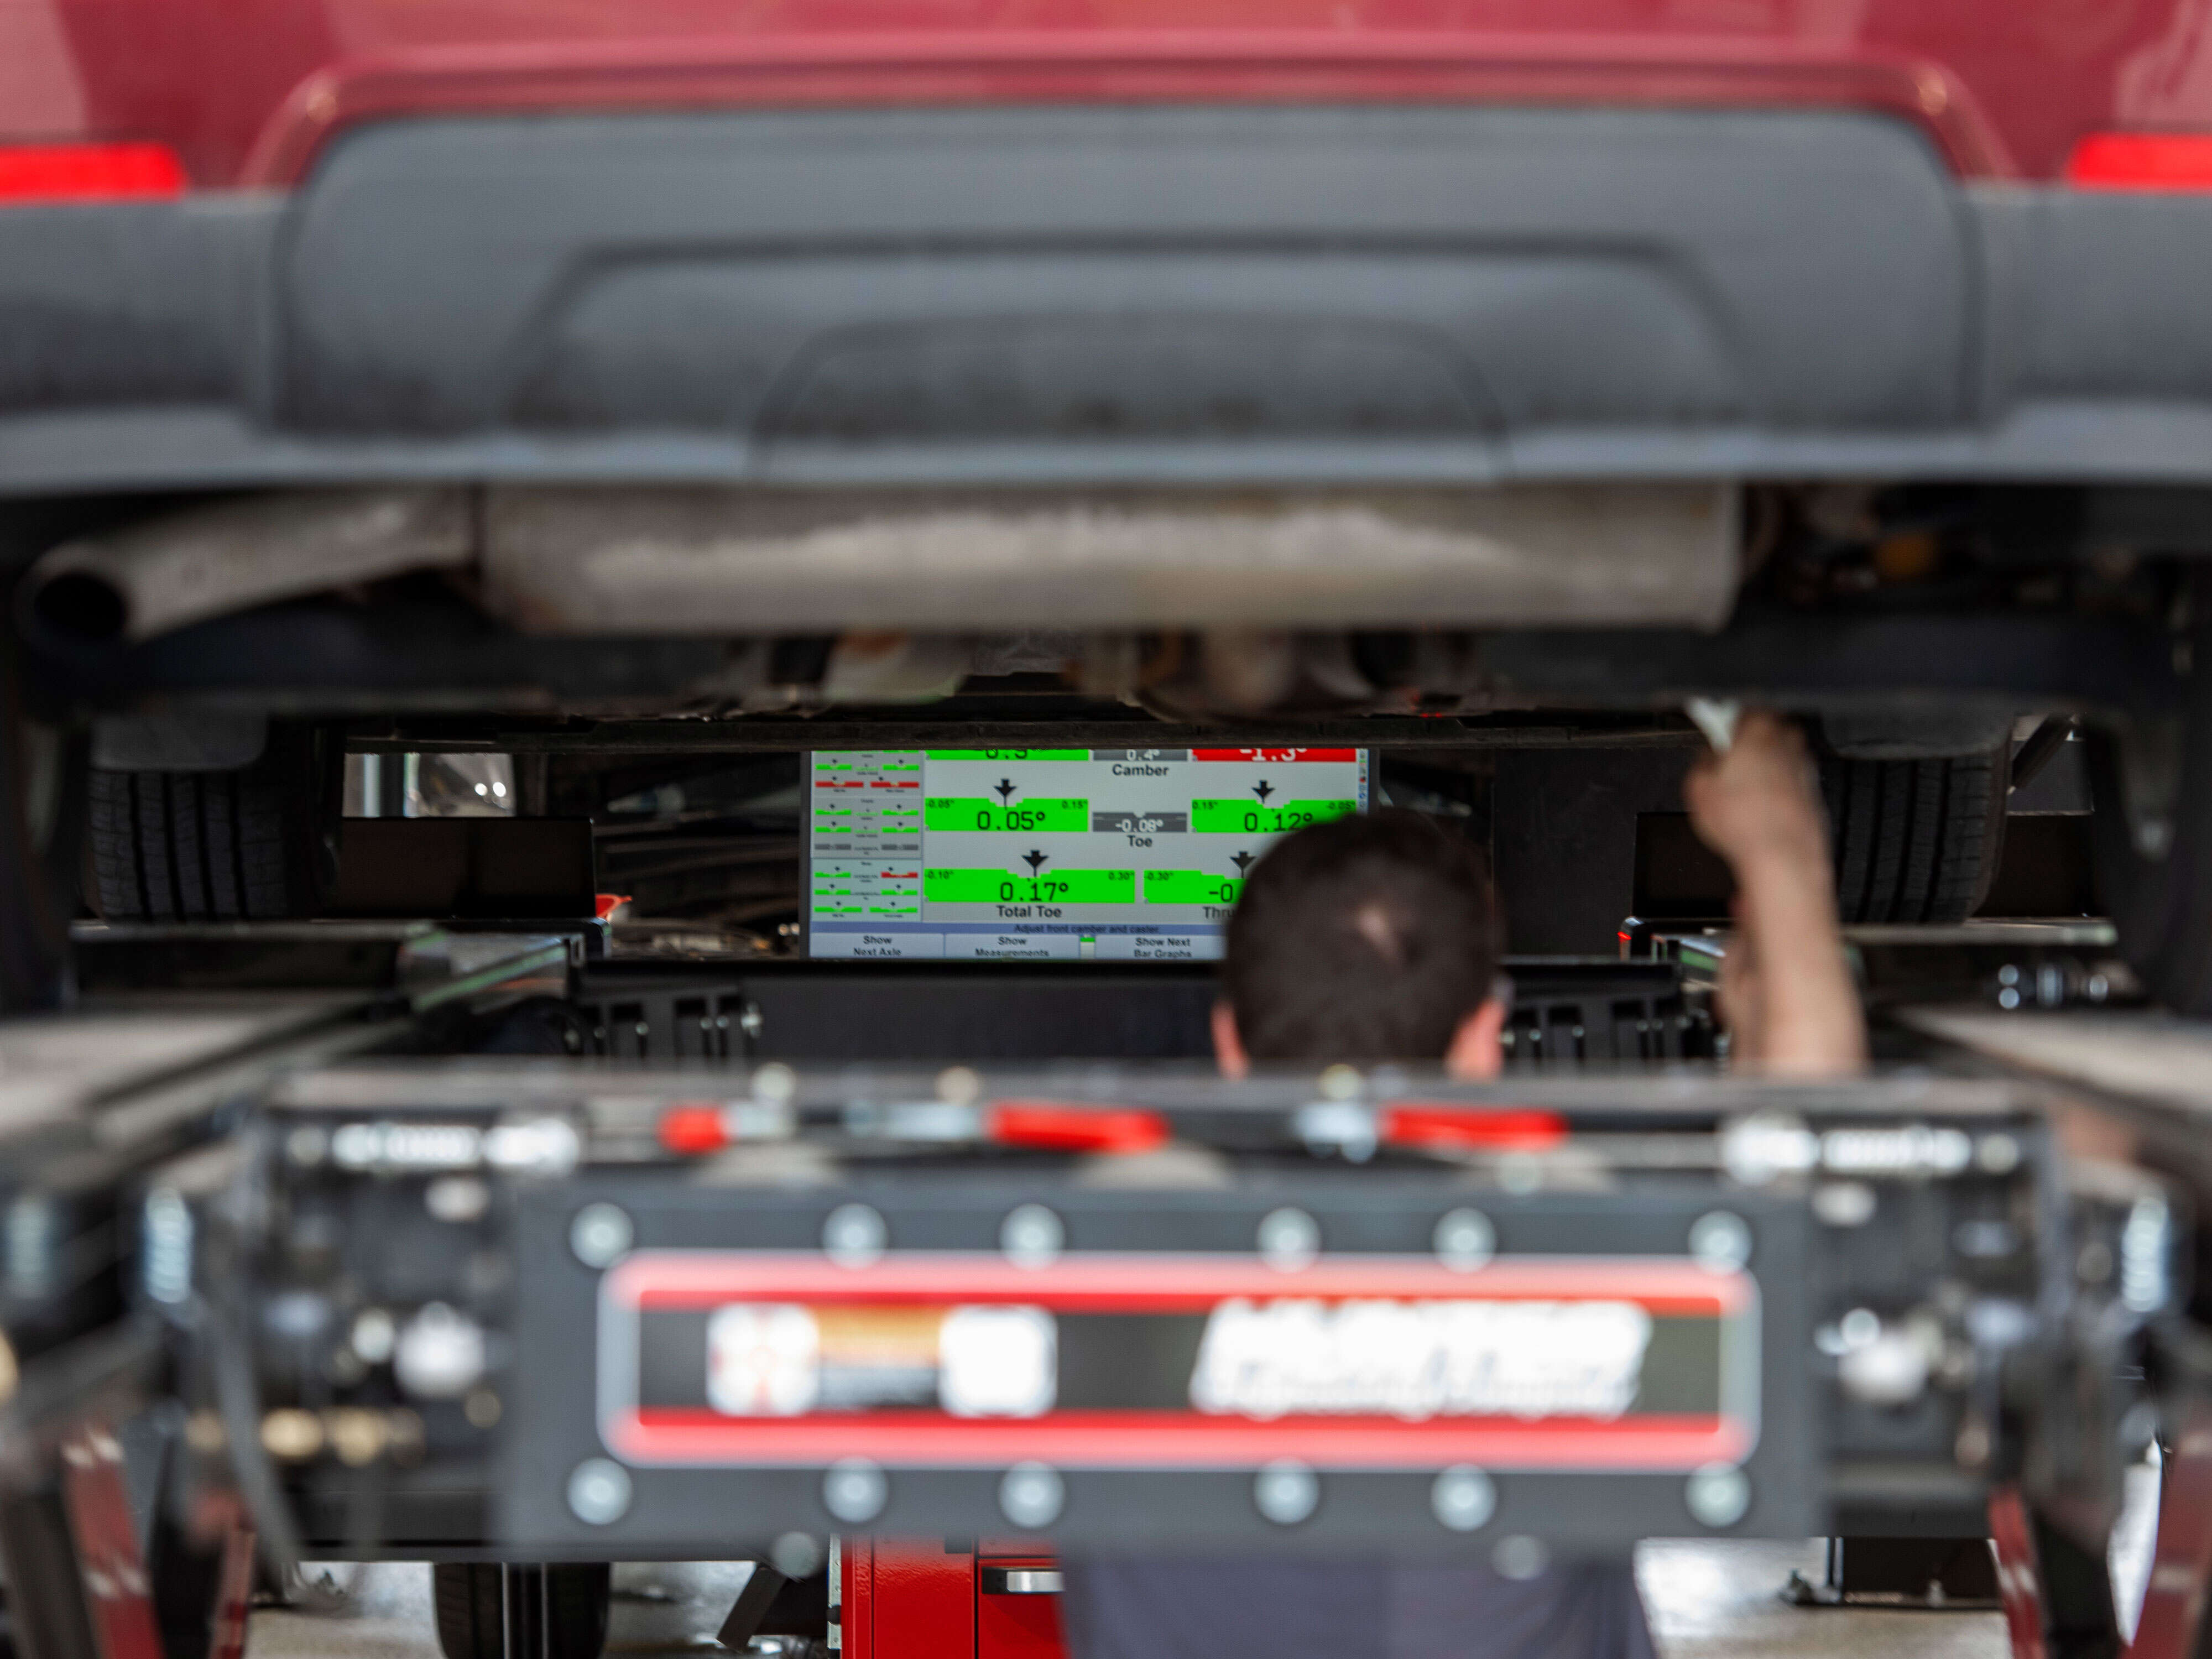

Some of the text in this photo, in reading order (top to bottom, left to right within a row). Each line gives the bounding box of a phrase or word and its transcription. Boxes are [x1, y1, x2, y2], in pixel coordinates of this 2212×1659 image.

[1112, 764, 1170, 776] Camber
[977, 811, 1045, 830] 0.05°
[1244, 812, 1313, 832] 0.12°
[1127, 834, 1153, 847] Toe
[1000, 882, 1069, 901] 0.17°
[1208, 884, 1234, 902] -0
[996, 905, 1062, 918] Total Toe
[1202, 906, 1236, 920] Thru
[1109, 926, 1128, 934] and
[863, 935, 892, 945] Show
[998, 936, 1027, 946] Show
[1135, 937, 1191, 947] Show Next
[853, 947, 902, 956] Next Axle
[974, 948, 1049, 957] Measurements
[1134, 949, 1192, 958] Bar Graphs
